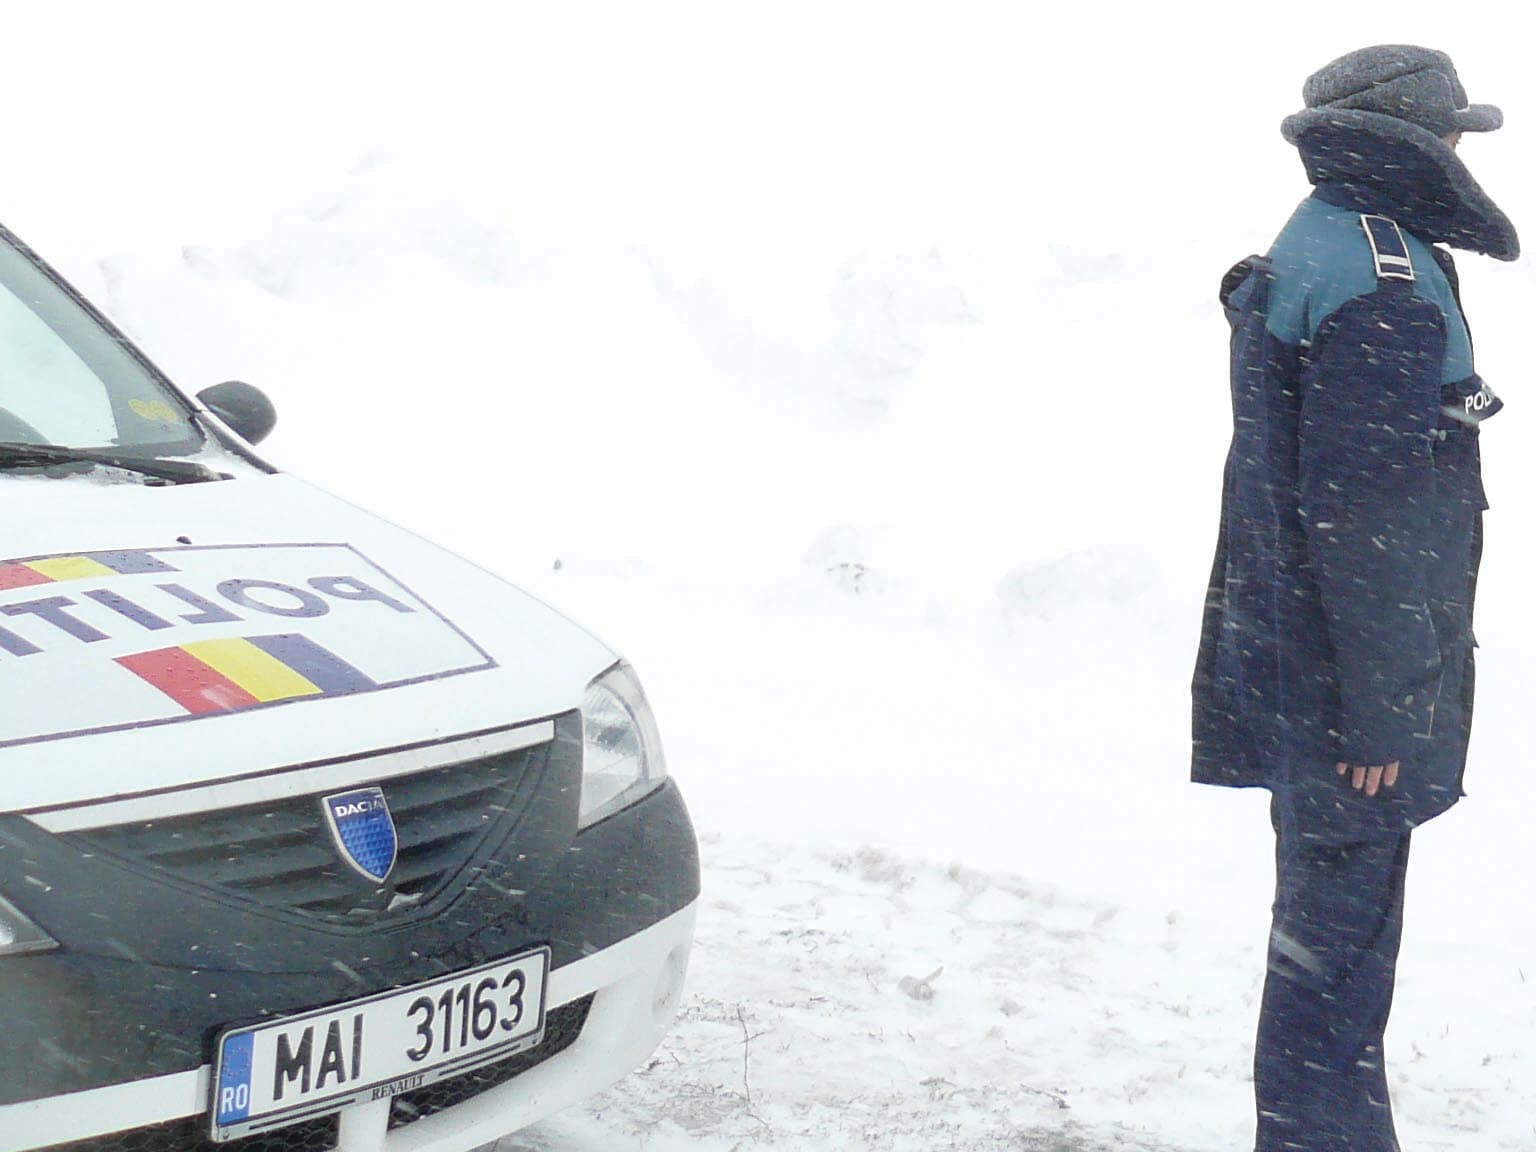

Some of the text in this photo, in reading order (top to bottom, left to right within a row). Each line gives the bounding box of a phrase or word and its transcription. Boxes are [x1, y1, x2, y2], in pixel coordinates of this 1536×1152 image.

[273, 968, 526, 1100] MAI 31163
[221, 1084, 248, 1113] RO
[371, 1075, 424, 1100] RENAULT
